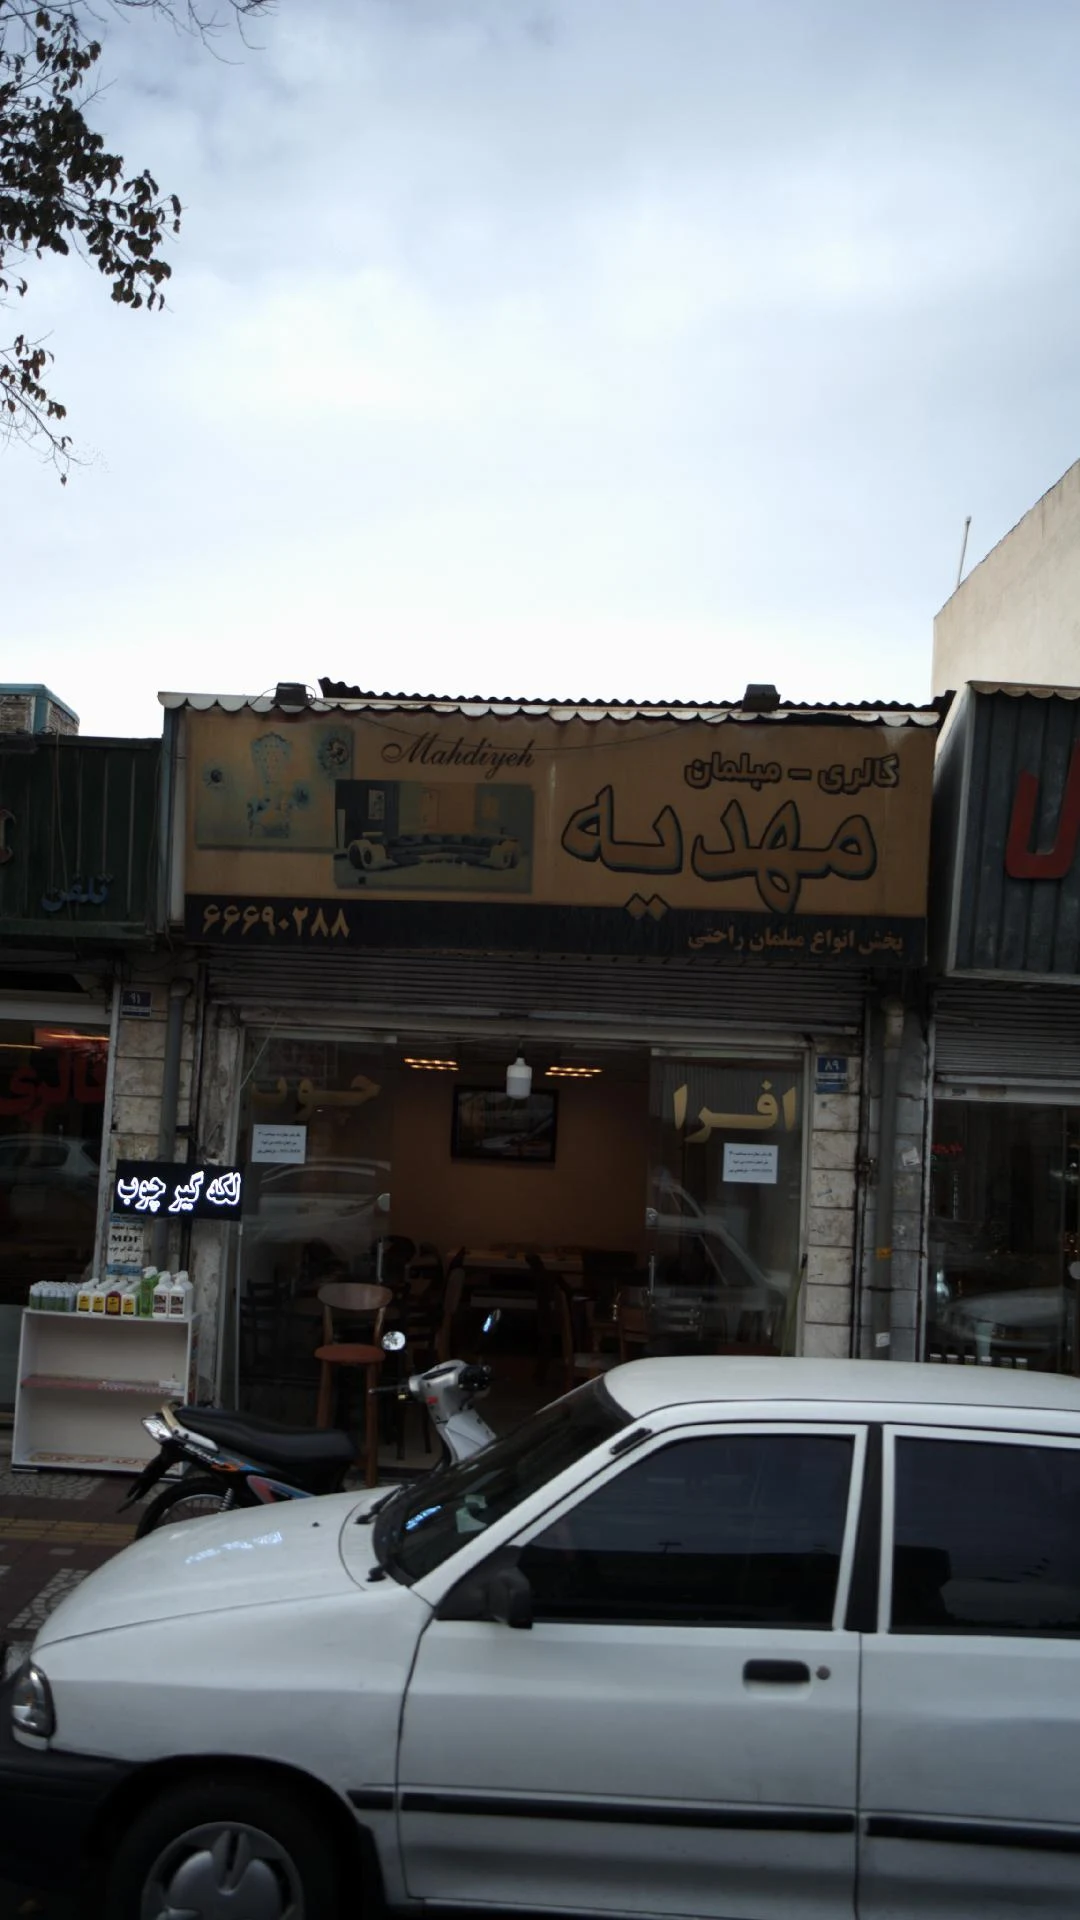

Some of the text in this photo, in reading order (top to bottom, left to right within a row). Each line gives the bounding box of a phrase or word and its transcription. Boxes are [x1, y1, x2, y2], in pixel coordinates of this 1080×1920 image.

[381, 732, 536, 780] Mahdiyeh
[684, 752, 782, 791] مبلمان
[818, 754, 900, 795] گالری
[561, 784, 877, 921] مهدیه
[202, 903, 351, 939] ۶۶۶۹۰۲۸۸
[687, 924, 904, 959] پخش انواع مبلمان راحتی
[673, 1079, 797, 1144] افرا
[116, 1170, 242, 1213] لکه گیر چوب
[111, 1234, 141, 1244] MDF
